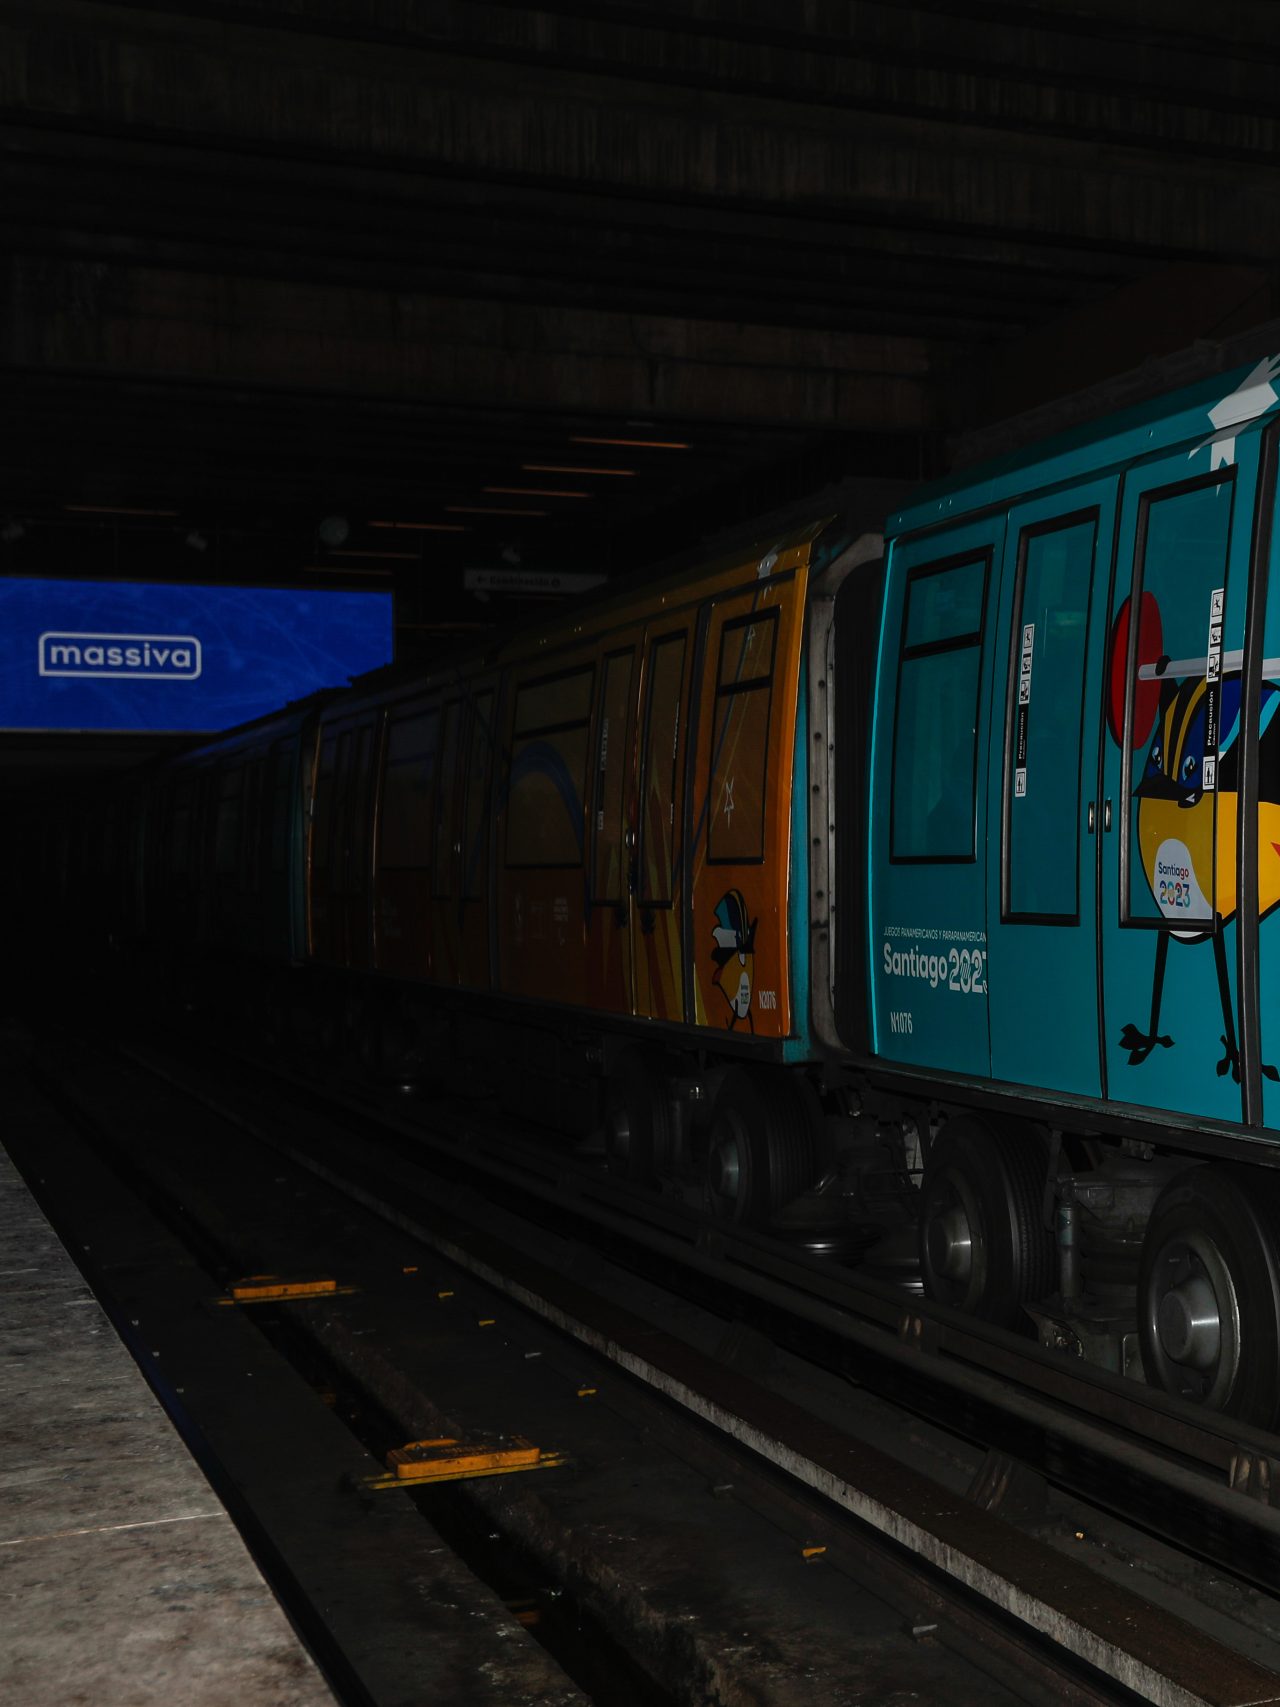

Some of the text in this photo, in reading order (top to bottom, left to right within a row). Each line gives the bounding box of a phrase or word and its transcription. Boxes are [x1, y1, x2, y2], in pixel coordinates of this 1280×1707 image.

[50, 641, 192, 670] massiva
[1158, 861, 1189, 880] Santiago
[1159, 880, 1190, 908] 2023
[883, 942, 948, 988] Santiago
[890, 1011, 913, 1035] N1076
